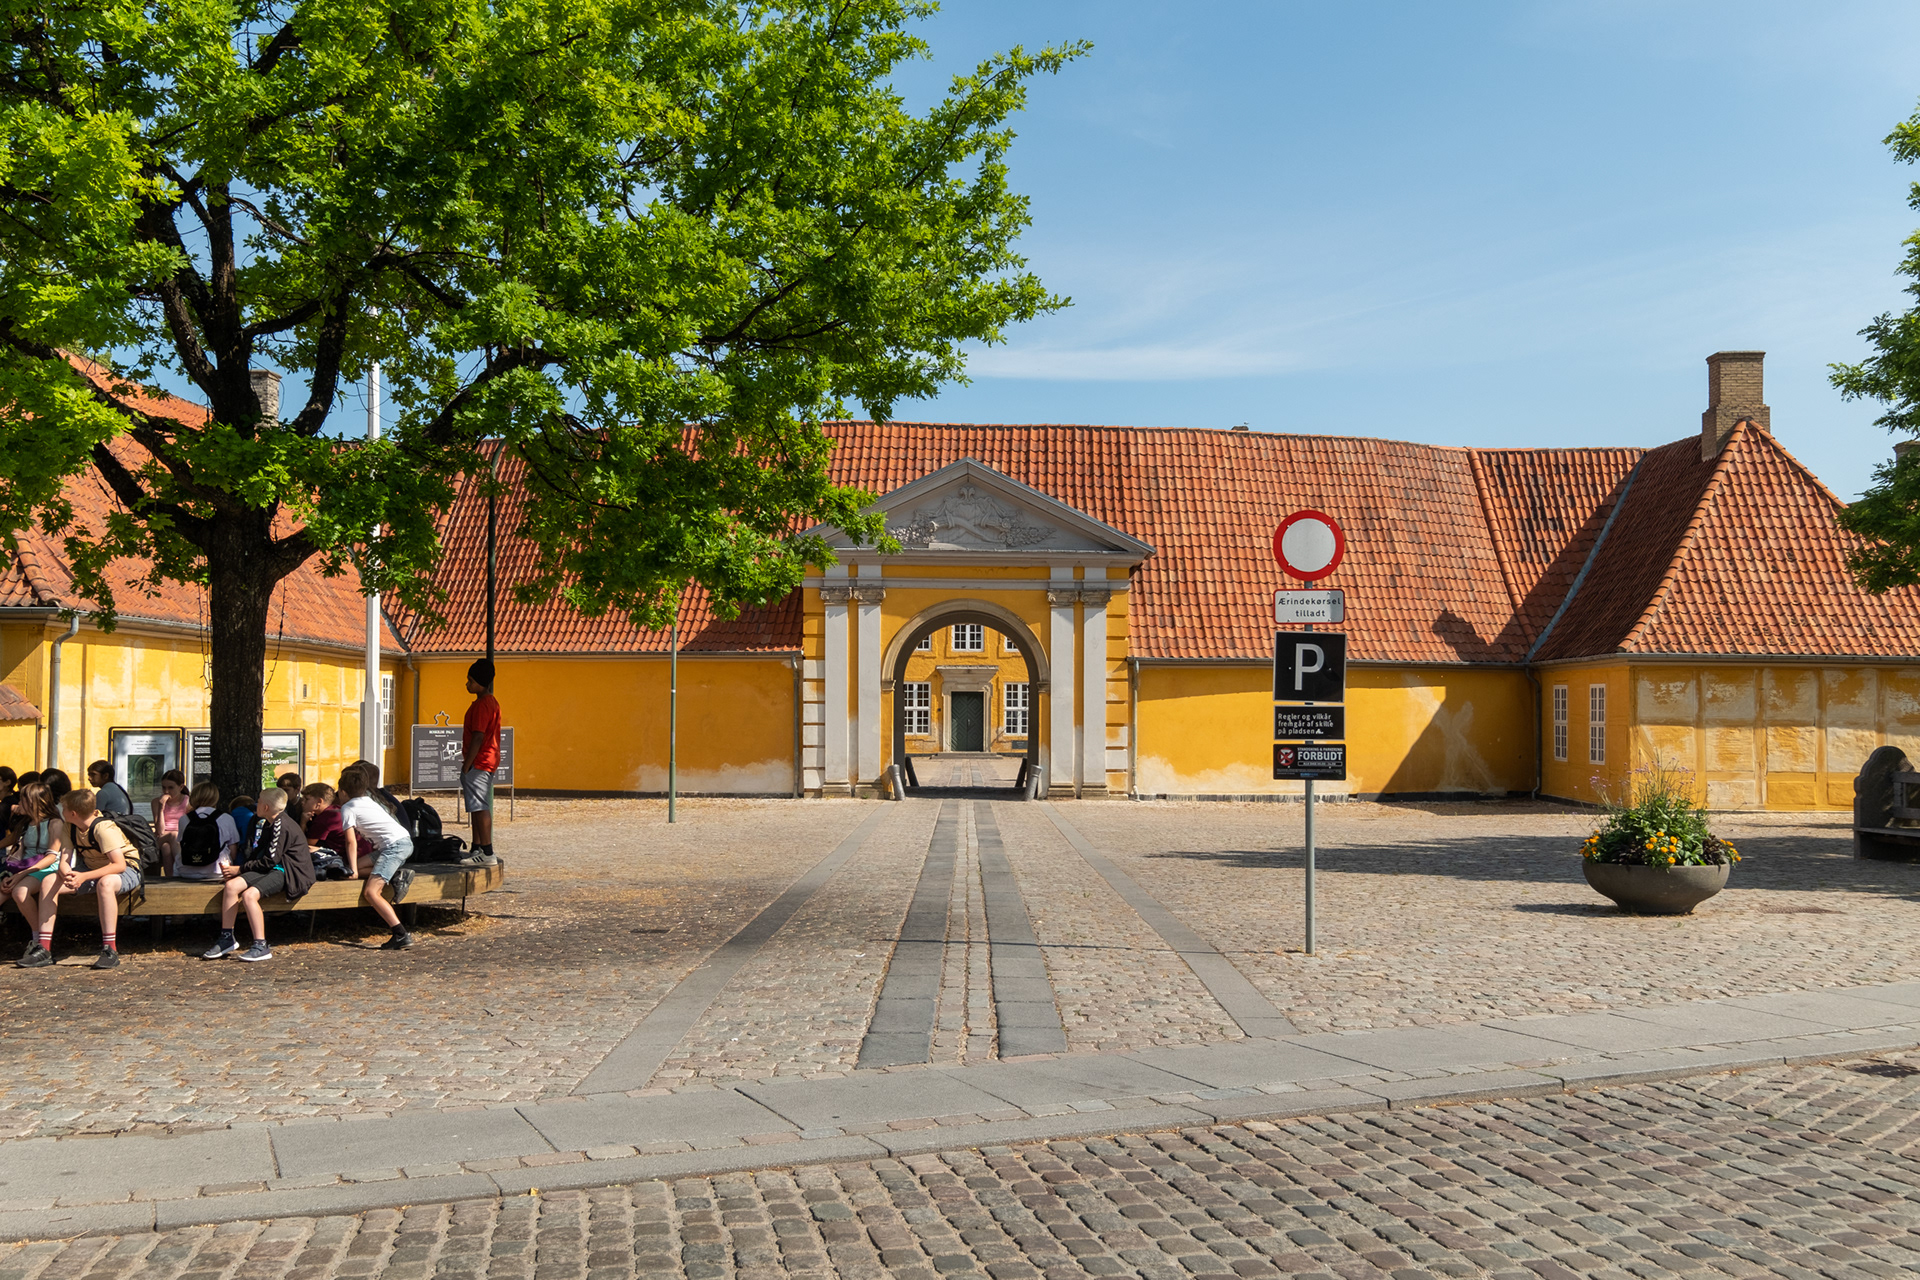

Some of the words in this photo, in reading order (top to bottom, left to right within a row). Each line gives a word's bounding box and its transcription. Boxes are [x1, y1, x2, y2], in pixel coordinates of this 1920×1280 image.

[1278, 597, 1341, 605] Ærindekørsel
[1295, 609, 1326, 617] tilladt
[1294, 643, 1325, 691] P
[1277, 713, 1300, 721] Regler
[1278, 720, 1305, 728] fremgår
[1297, 751, 1343, 761] FORBUDT
